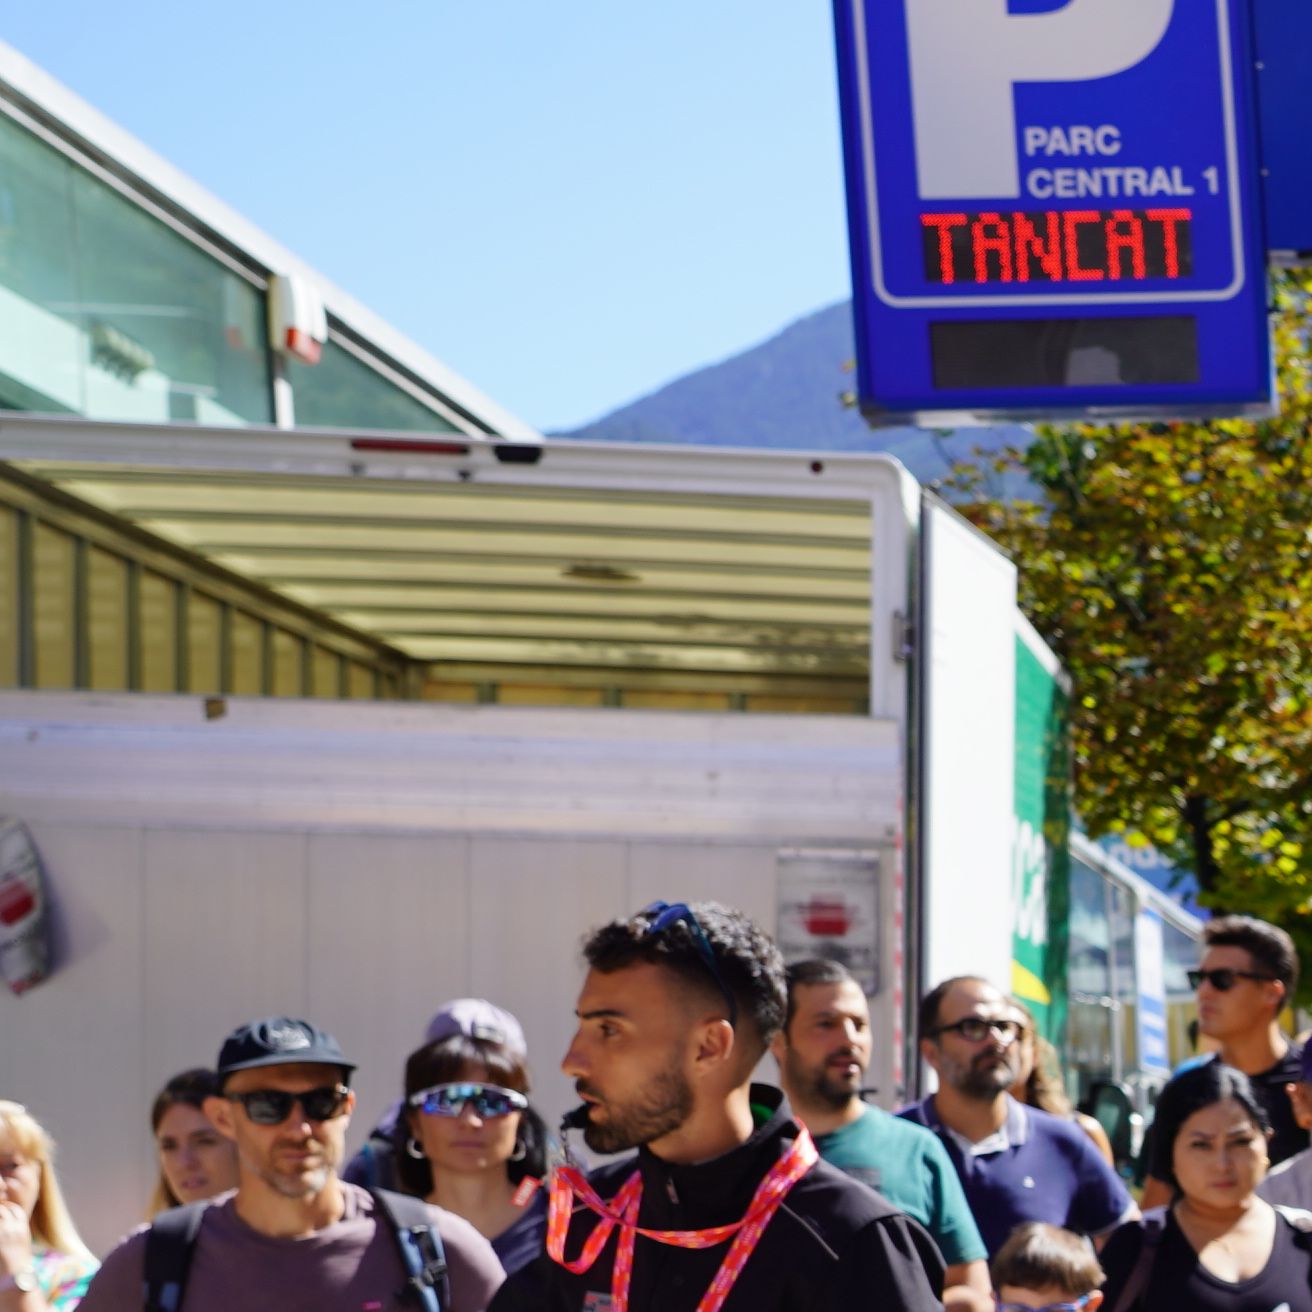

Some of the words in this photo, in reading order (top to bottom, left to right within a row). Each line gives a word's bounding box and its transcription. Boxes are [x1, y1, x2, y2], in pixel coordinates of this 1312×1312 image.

[1024, 126, 1121, 156] PARC
[1027, 168, 1194, 198] CENTRAL
[1202, 167, 1219, 195] 1
[920, 208, 1192, 284] TANCAT
